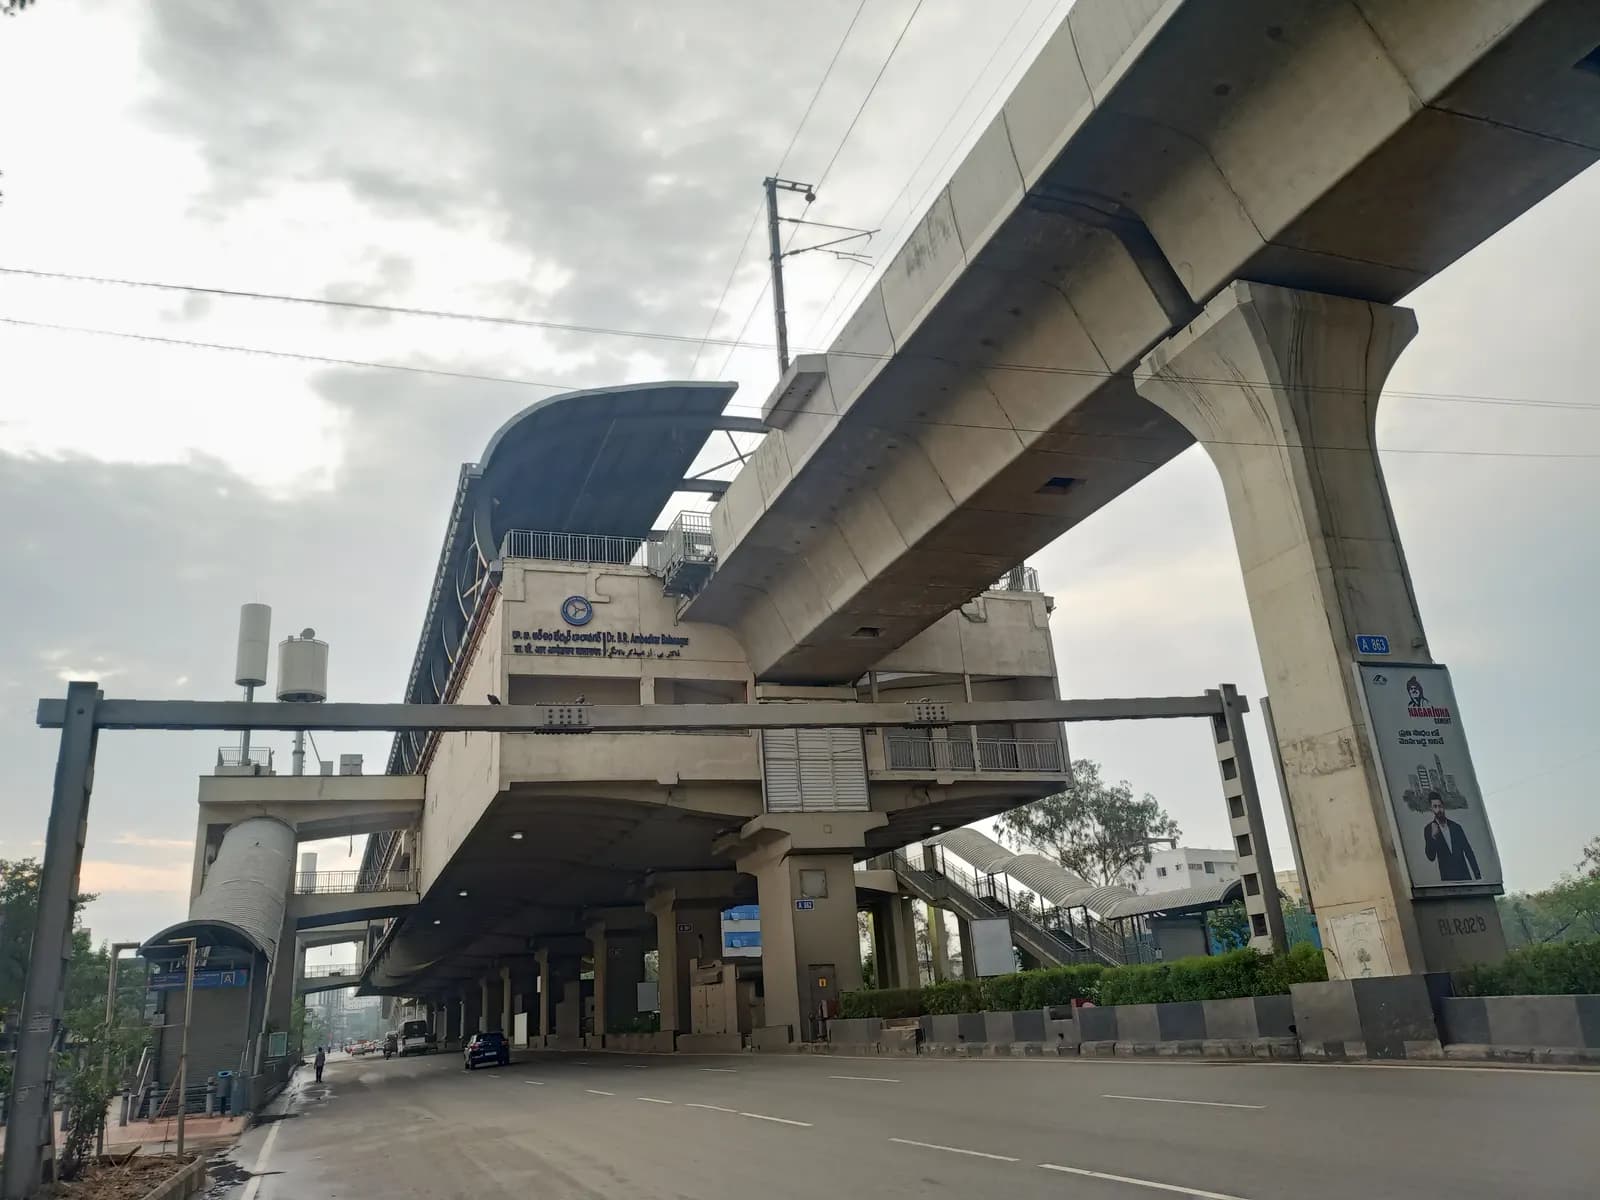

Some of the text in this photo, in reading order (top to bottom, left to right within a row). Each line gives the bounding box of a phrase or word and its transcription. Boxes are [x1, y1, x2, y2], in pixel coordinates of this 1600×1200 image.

[606, 631, 616, 643] Dr.
[1361, 638, 1369, 651] A
[223, 974, 232, 983] A
